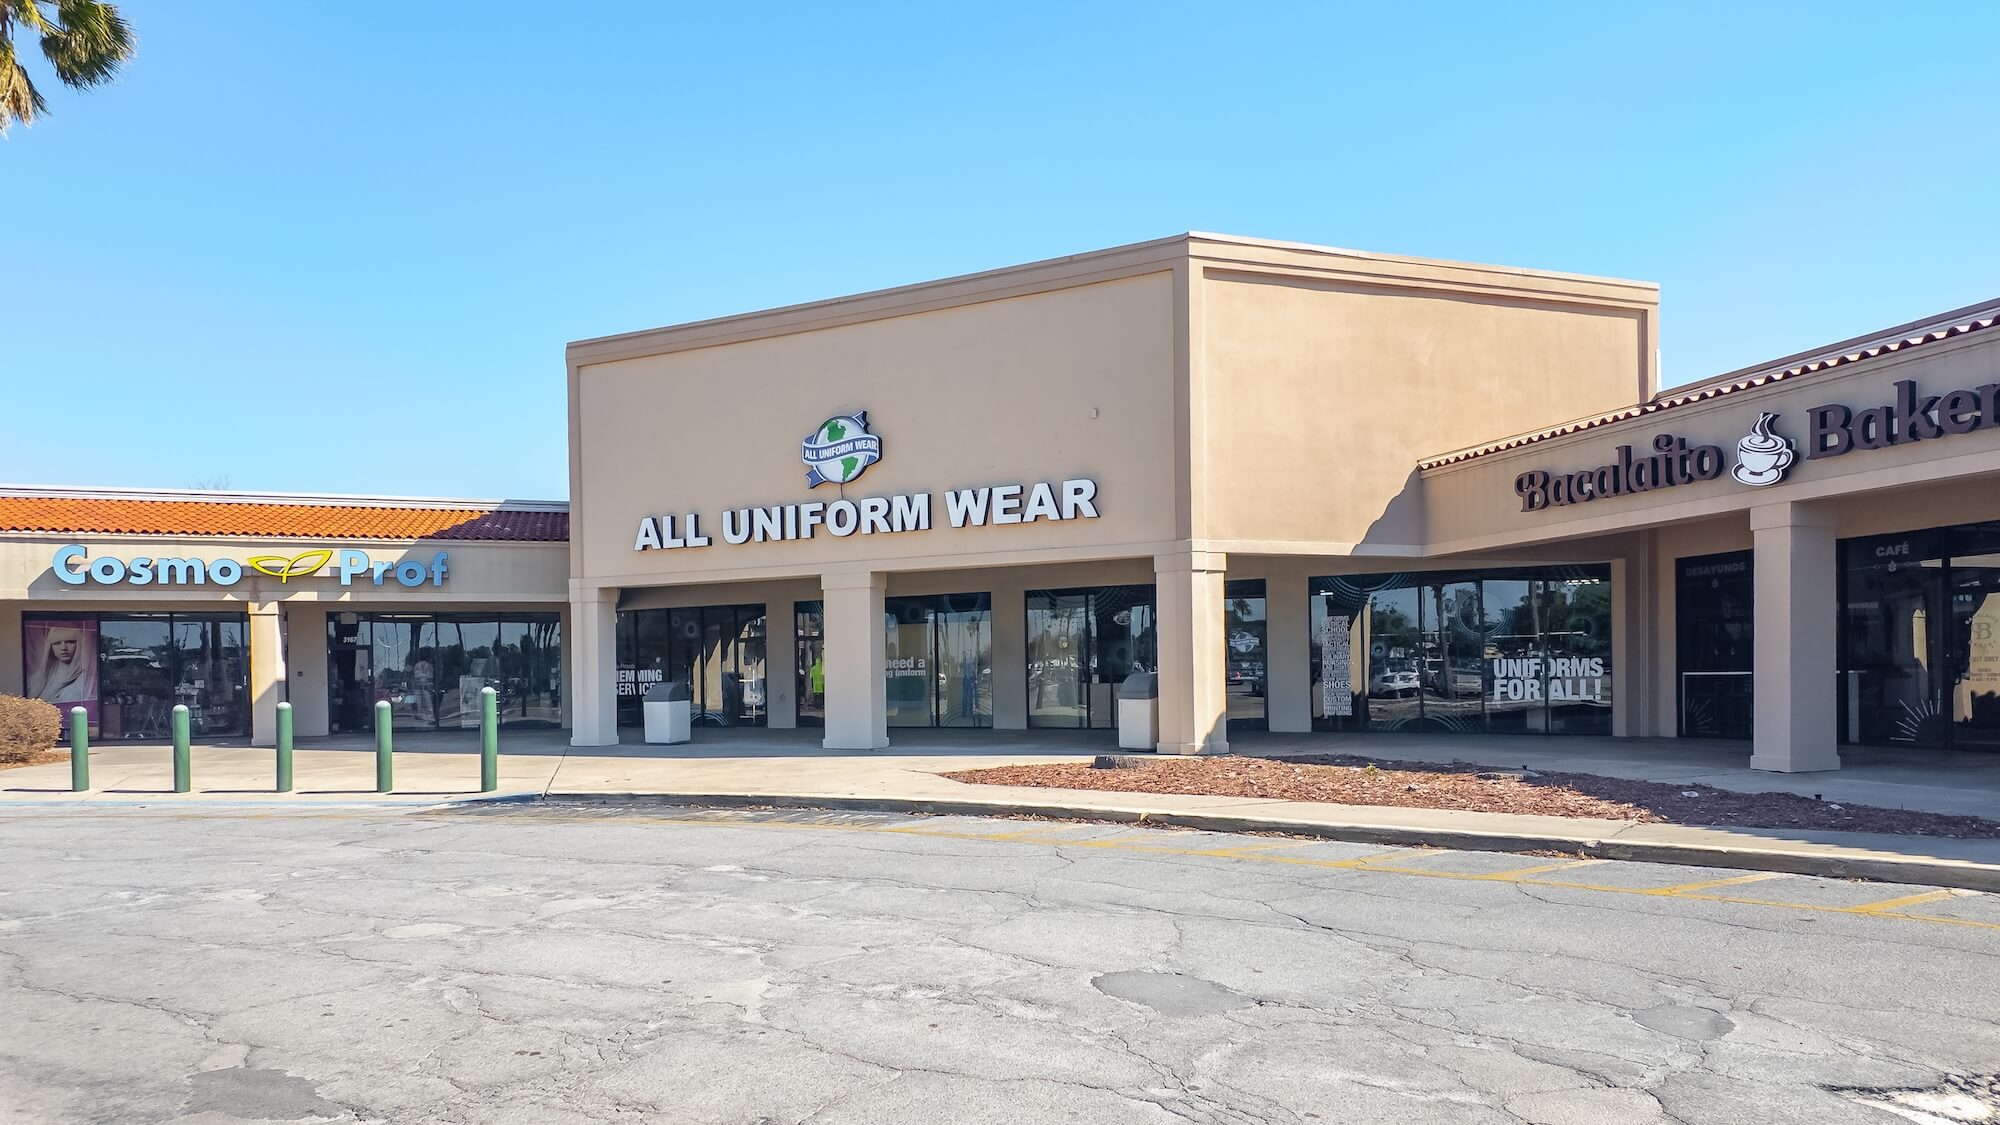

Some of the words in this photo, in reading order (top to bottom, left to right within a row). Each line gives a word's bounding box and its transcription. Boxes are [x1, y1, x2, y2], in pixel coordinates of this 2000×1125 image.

[804, 450, 818, 460] ALL
[819, 442, 853, 459] UNIFORM
[855, 440, 878, 451] WEAR
[1514, 433, 1725, 513] Bacalaito
[633, 513, 713, 552] ALL
[721, 492, 932, 545] UNIFORM
[943, 477, 1101, 529] WEAR
[1876, 541, 1909, 557] CAFÉ
[52, 544, 243, 586] Cosmo
[340, 548, 450, 586] Prof
[1686, 562, 1746, 577] DESAYUNOS
[885, 656, 914, 669] need
[917, 658, 926, 668] a
[1494, 658, 1604, 678] UNIFORMS
[895, 669, 926, 677] uniform
[1323, 680, 1351, 688] SHOES
[1494, 679, 1540, 700] FOR
[1549, 679, 1601, 700] ALL!
[1323, 695, 1351, 703] CUSTOM
